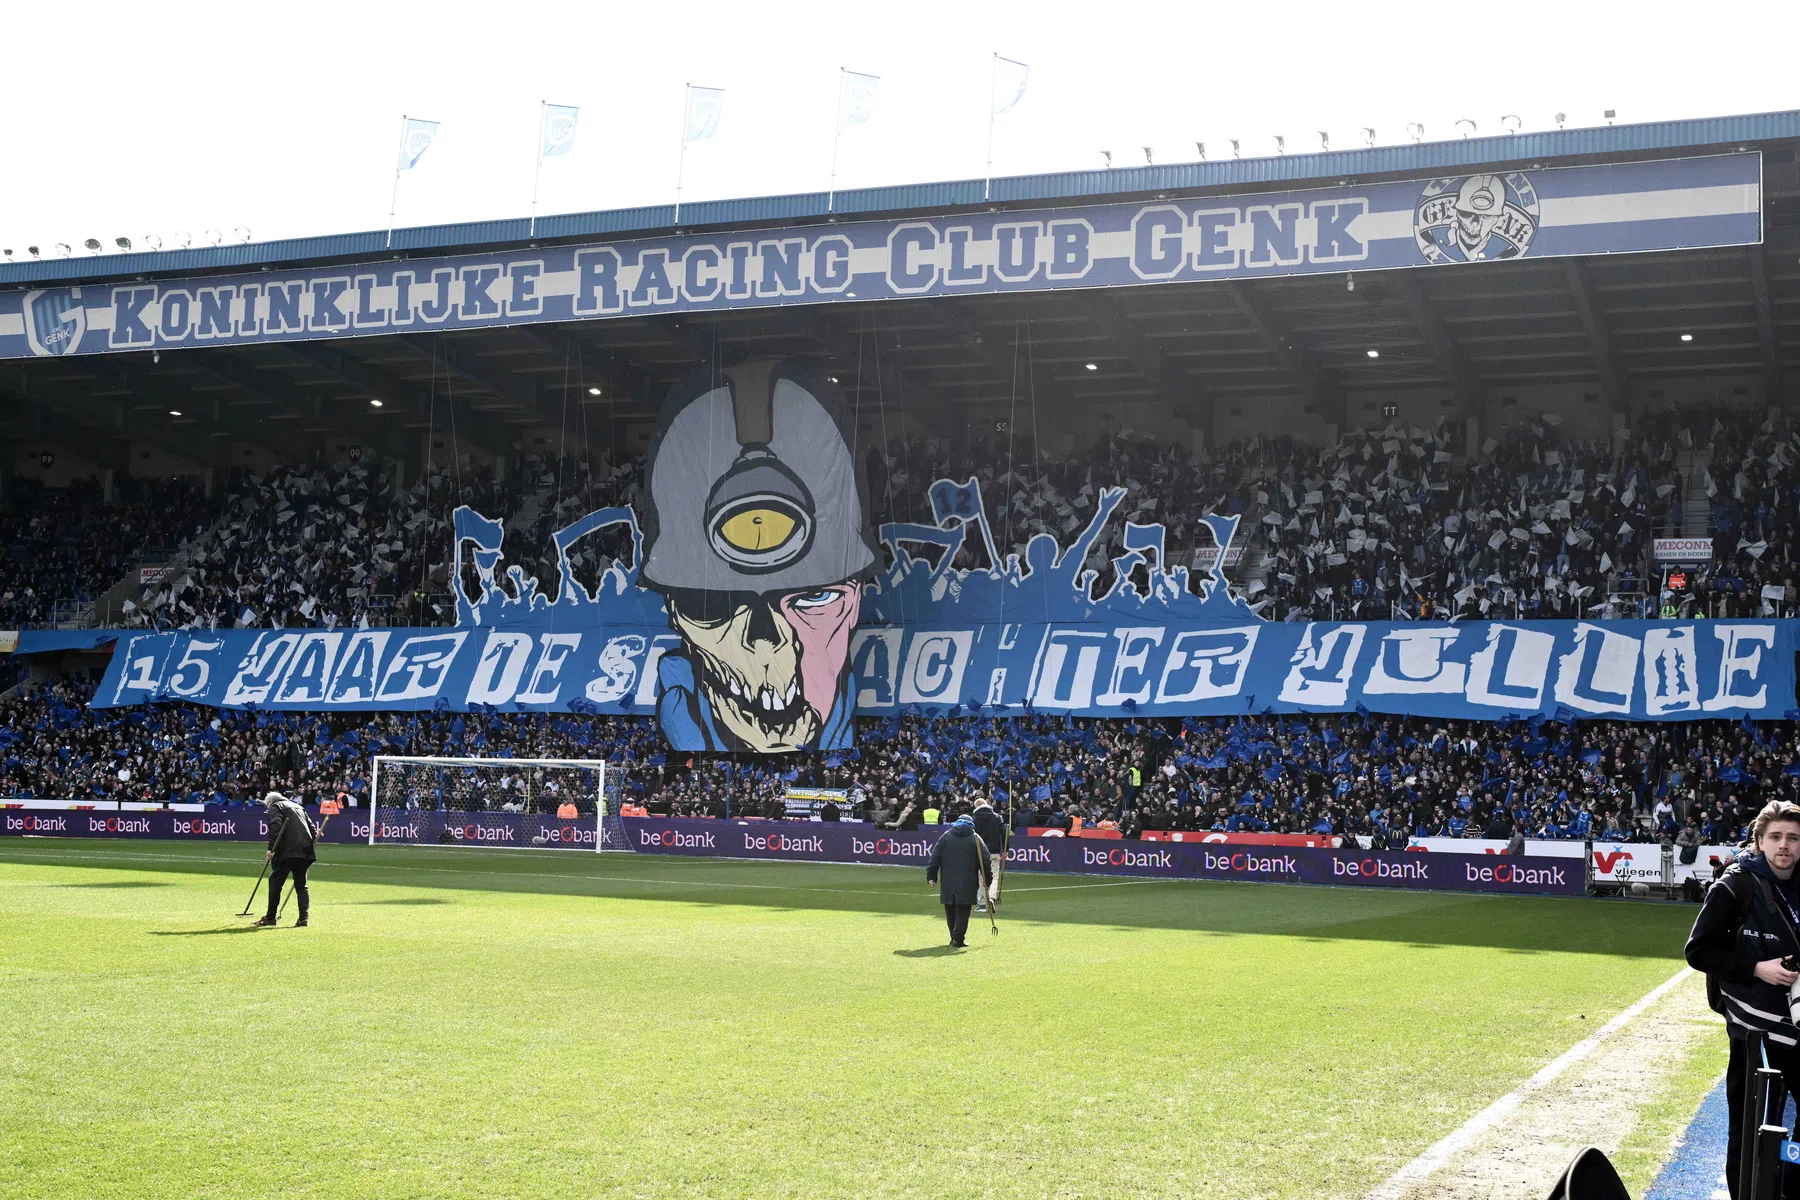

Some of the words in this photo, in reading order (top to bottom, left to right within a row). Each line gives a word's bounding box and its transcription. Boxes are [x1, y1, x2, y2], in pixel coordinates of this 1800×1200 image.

[108, 259, 545, 349] KONINKLIJKE
[573, 234, 854, 316] RACING
[886, 217, 1095, 294] CLUB
[1129, 197, 1369, 280] GENK
[45, 328, 71, 345] GENK
[1383, 406, 1397, 416] TT
[42, 456, 53, 464] PP
[126, 639, 221, 696] 15
[465, 632, 581, 704] DE
[851, 624, 1260, 708] ACHTER
[1279, 624, 1774, 715] JULLIE
[1002, 843, 1051, 862] bank
[1615, 867, 1661, 878] vliegen
